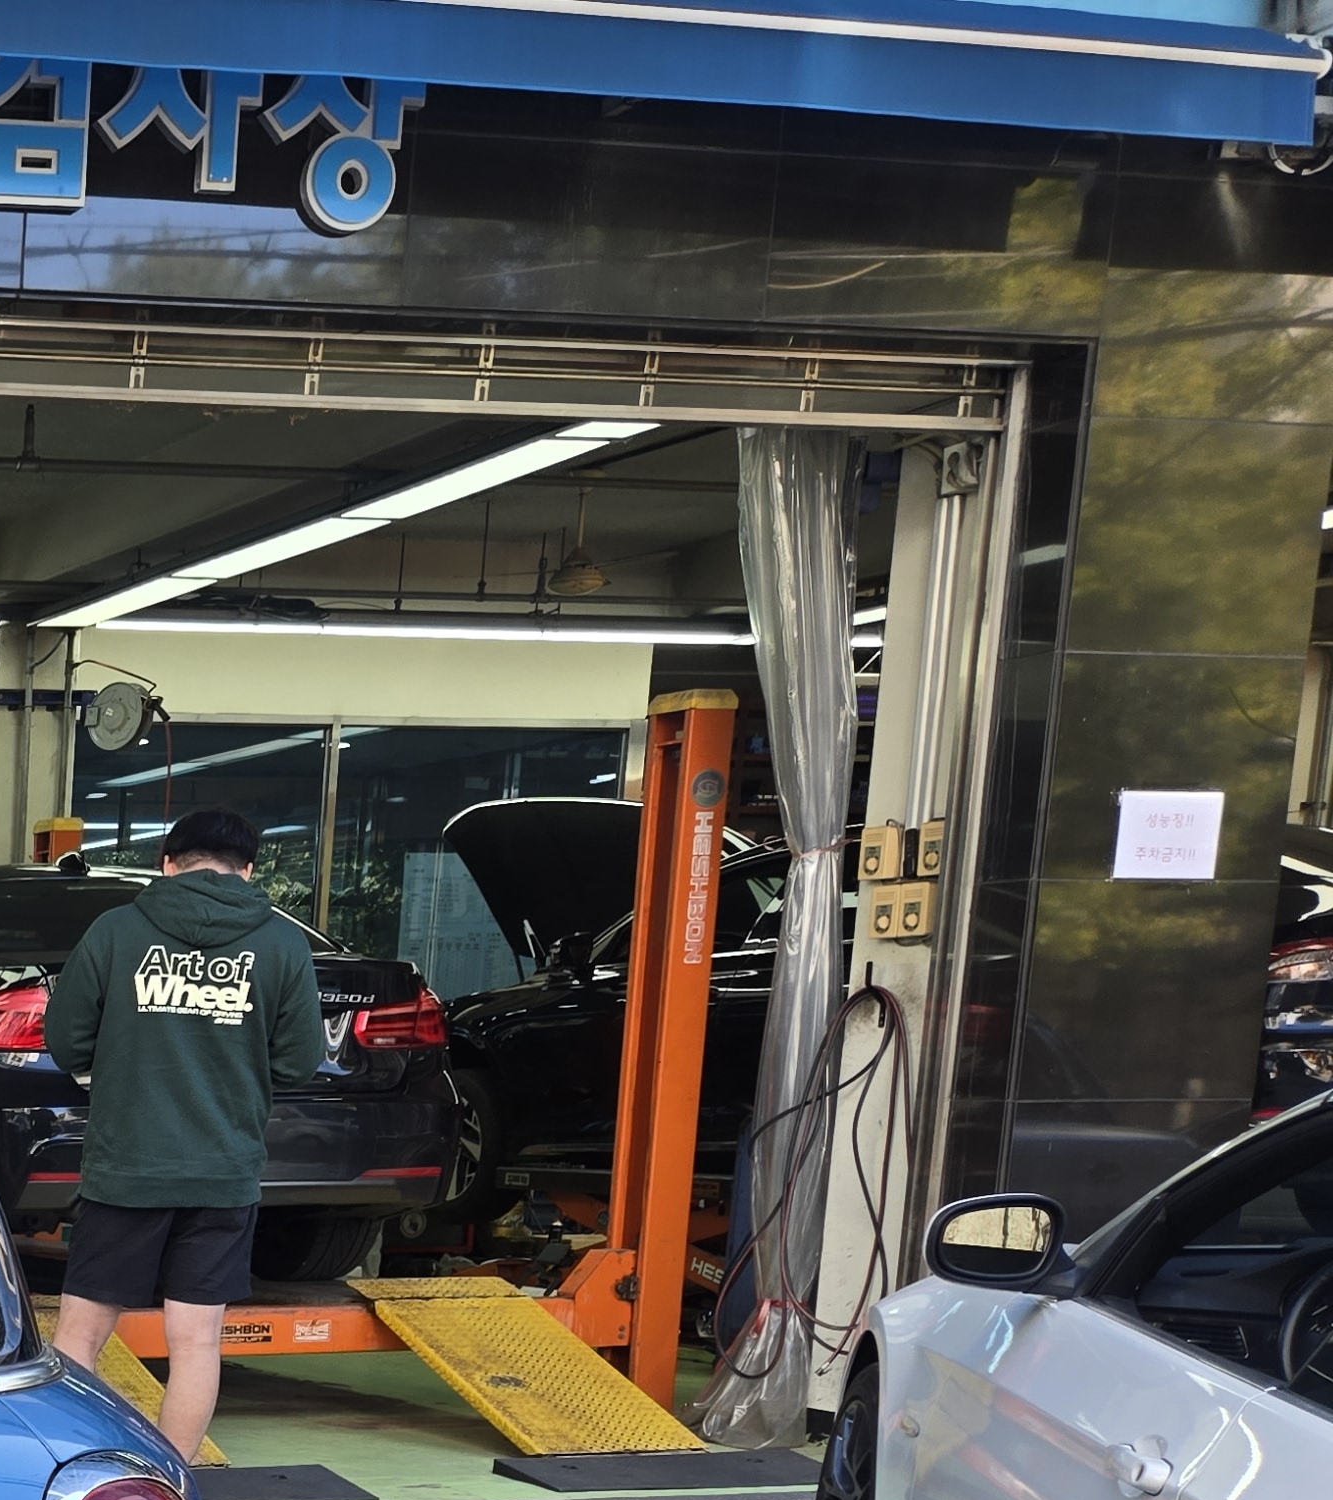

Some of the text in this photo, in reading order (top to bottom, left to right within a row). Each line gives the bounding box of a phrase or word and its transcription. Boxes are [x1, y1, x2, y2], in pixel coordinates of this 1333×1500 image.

[1145, 812, 1195, 829] 성능장!!
[1135, 846, 1196, 863] 주차금지!!
[684, 811, 715, 964] HESHBON
[135, 944, 256, 983] Art of
[221, 1324, 271, 1335] SHBON
